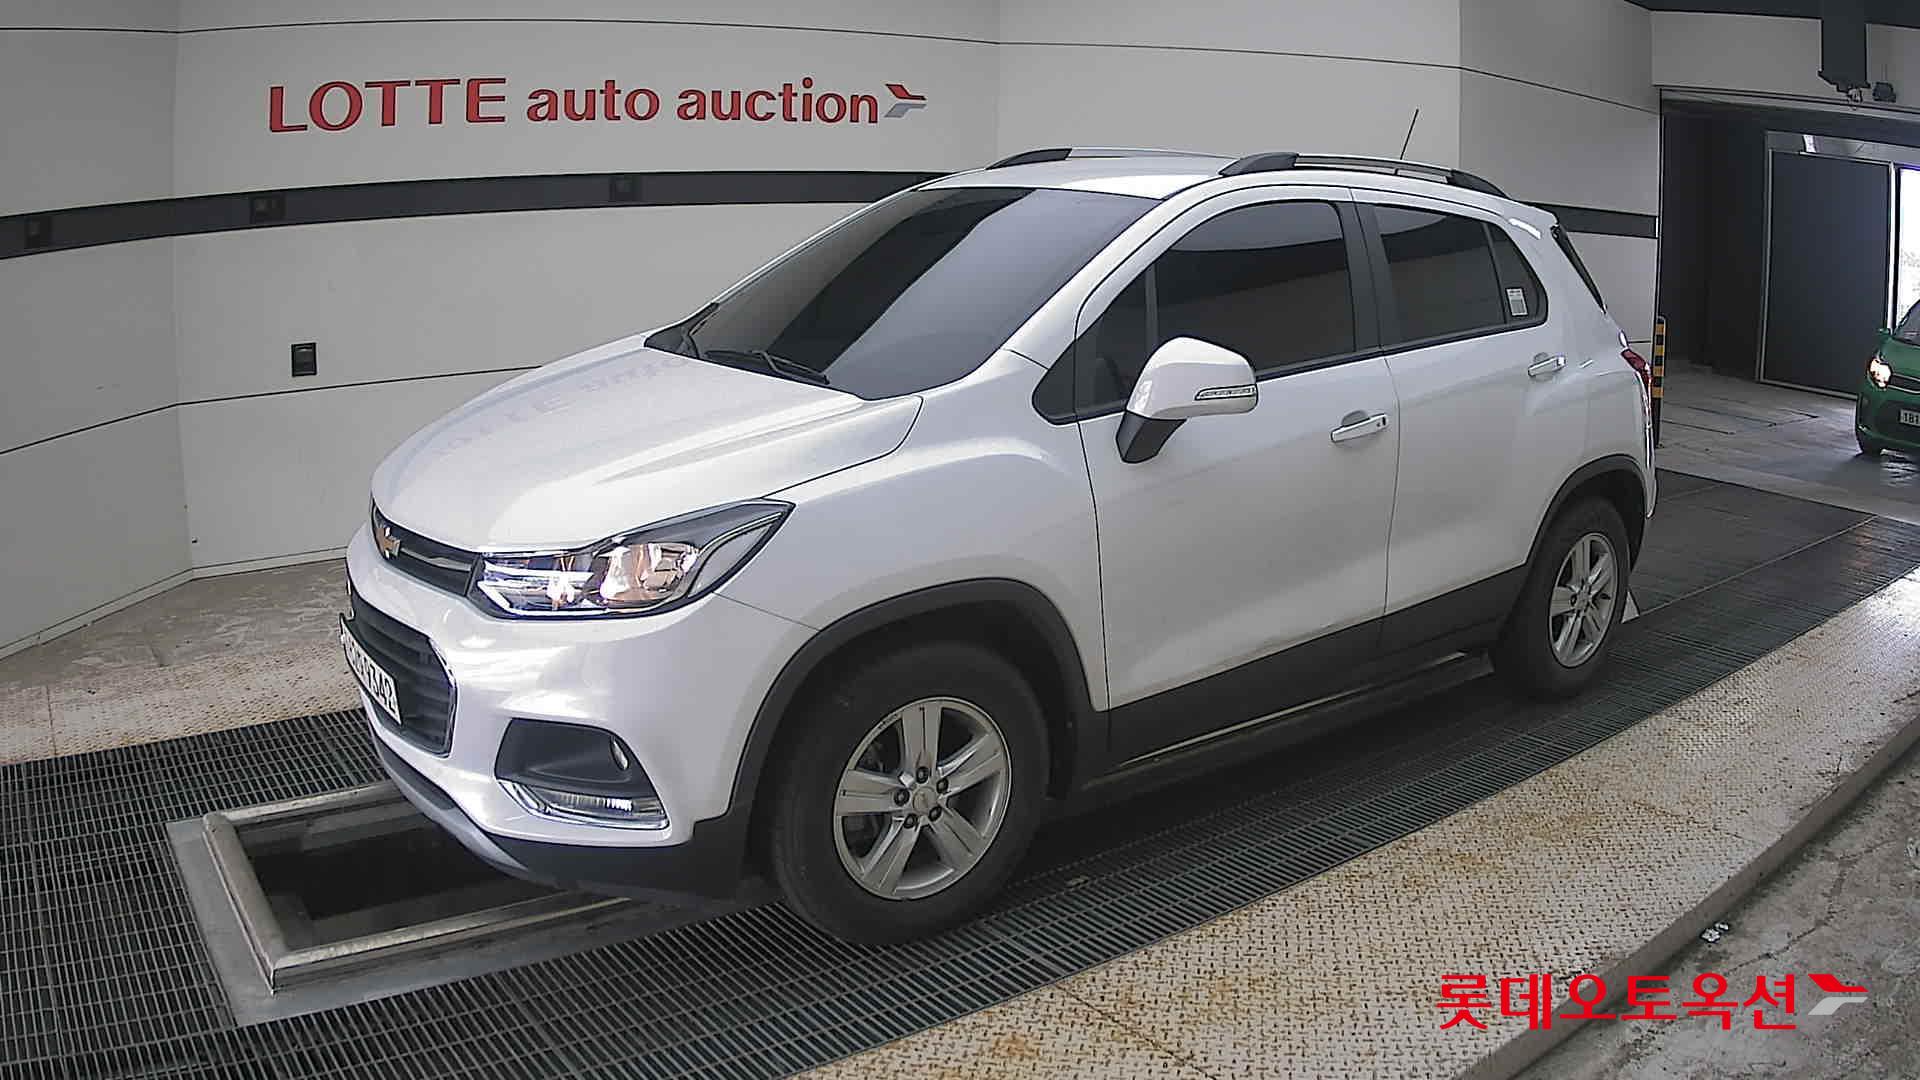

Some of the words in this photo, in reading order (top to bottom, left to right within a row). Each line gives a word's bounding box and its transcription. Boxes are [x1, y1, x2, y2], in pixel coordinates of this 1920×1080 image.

[268, 77, 507, 133] LOTTE
[525, 79, 661, 122] auto
[675, 77, 880, 124] auction
